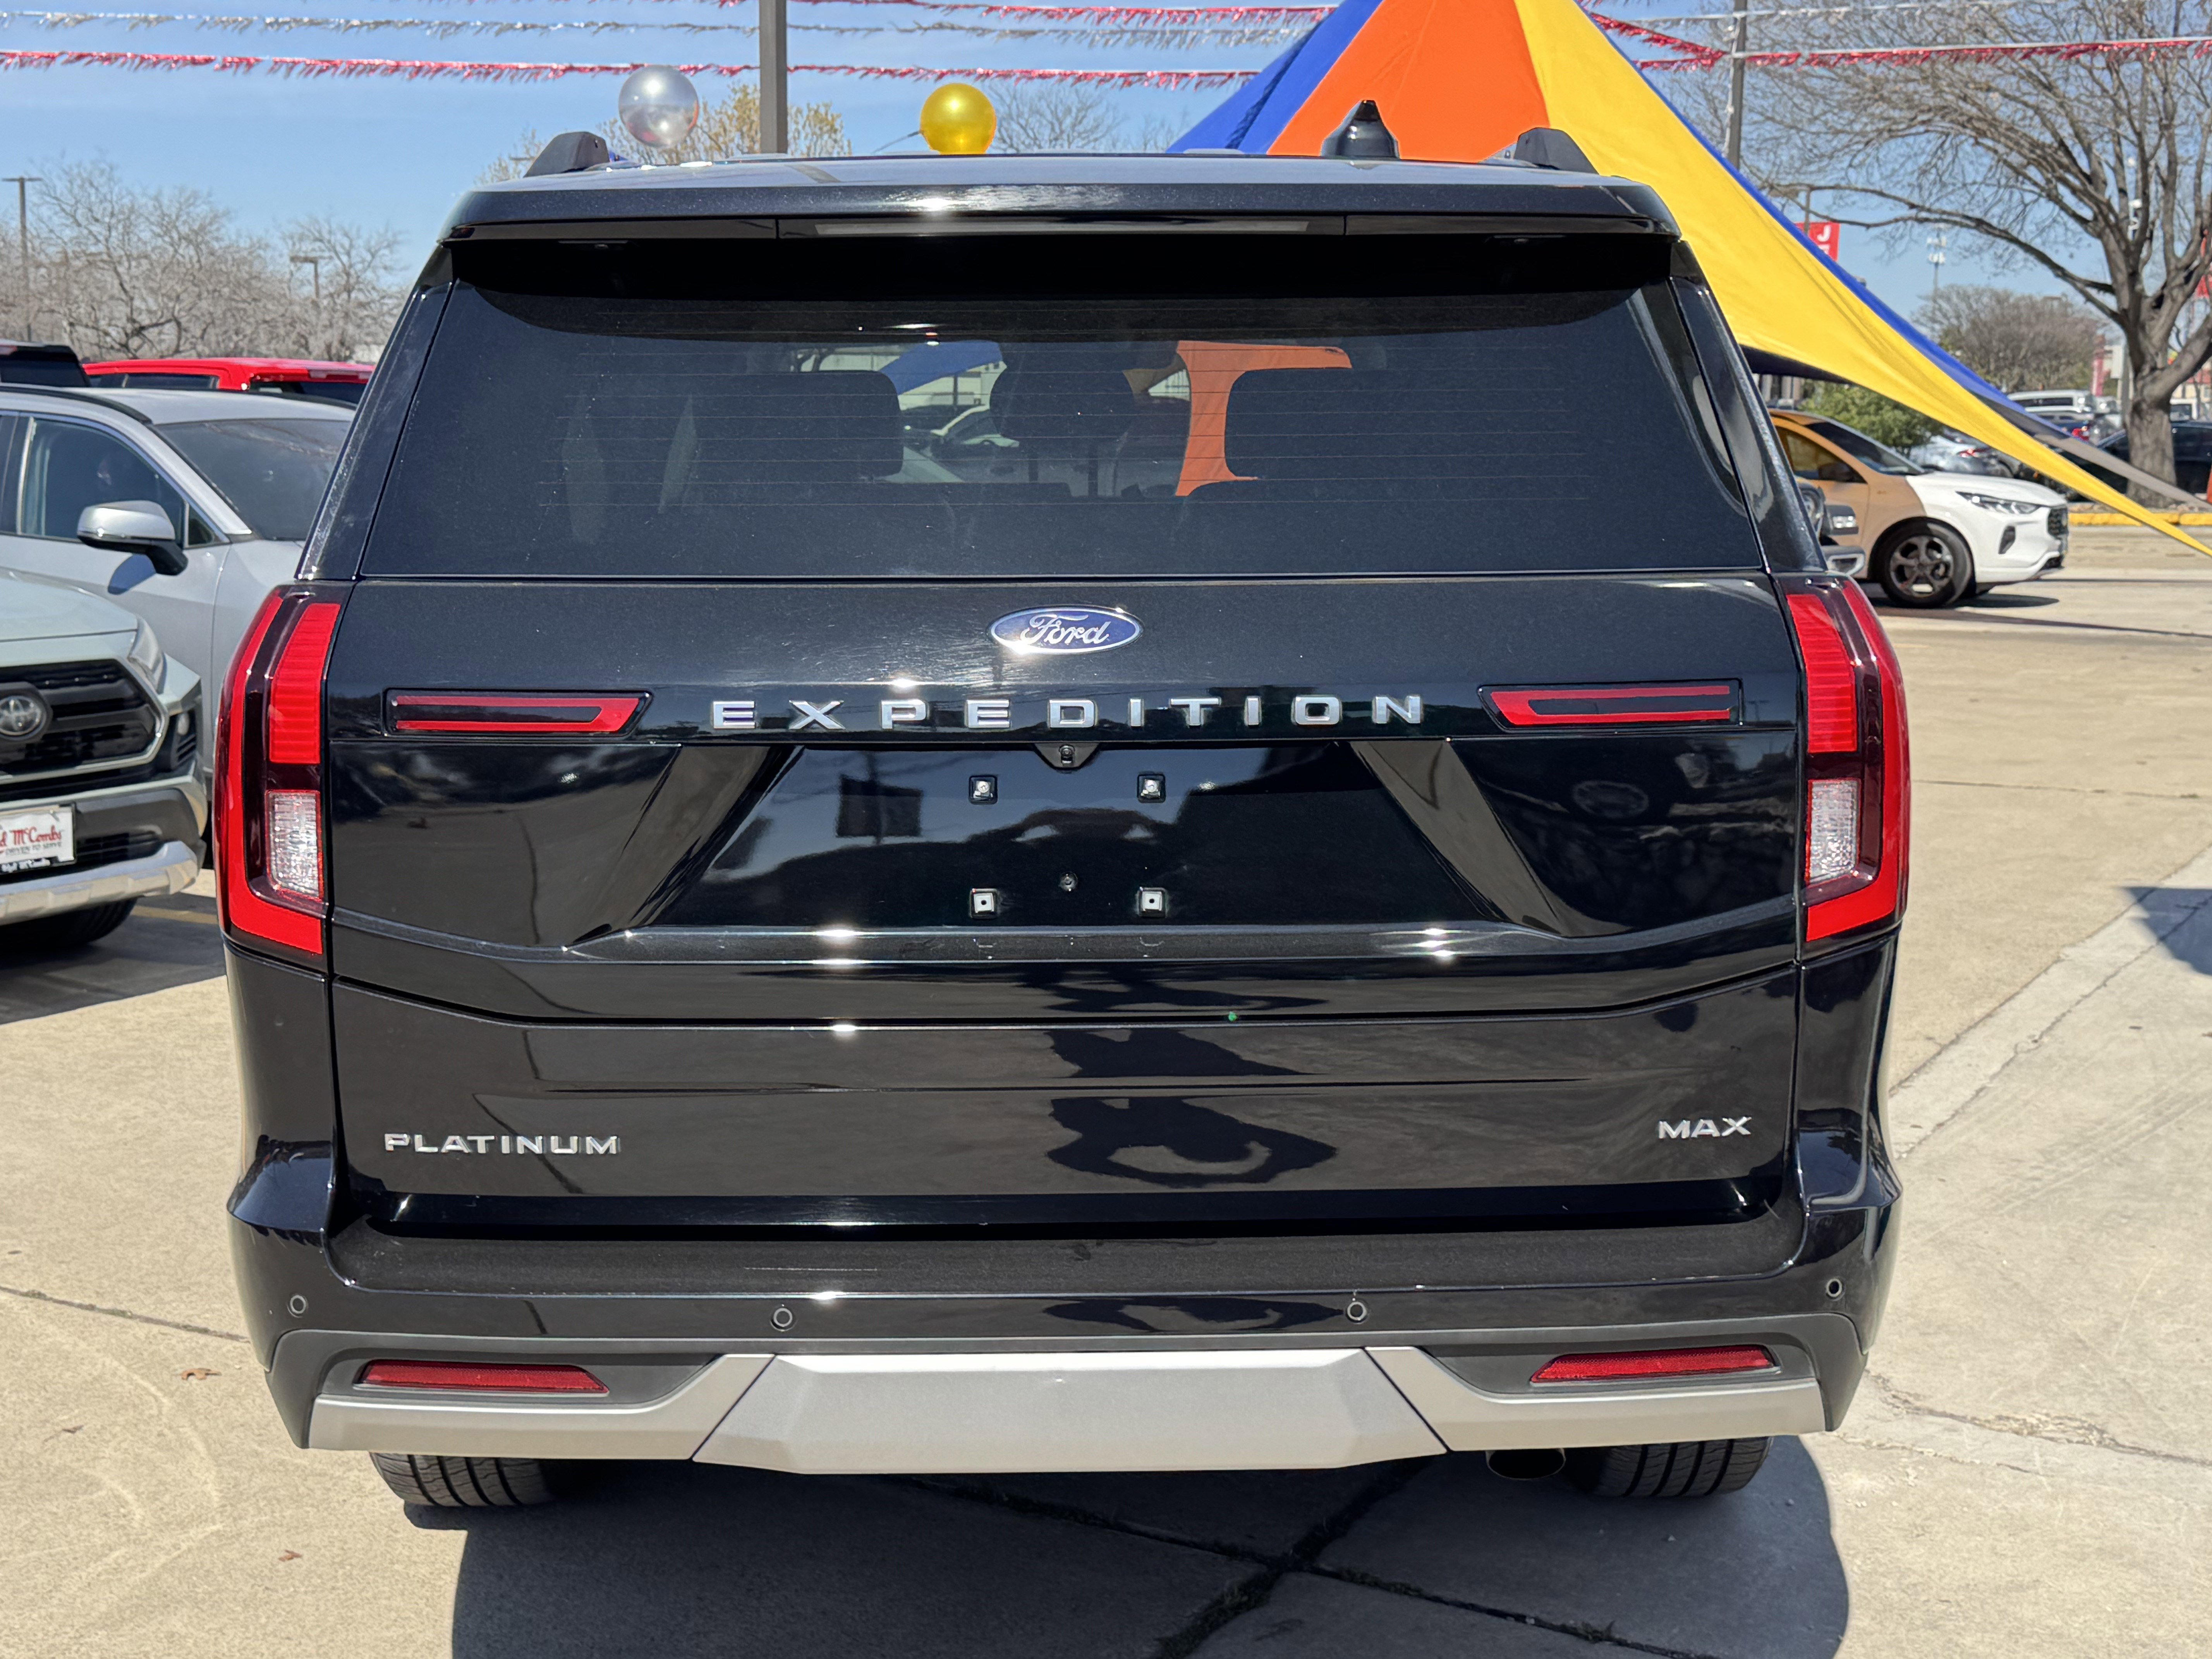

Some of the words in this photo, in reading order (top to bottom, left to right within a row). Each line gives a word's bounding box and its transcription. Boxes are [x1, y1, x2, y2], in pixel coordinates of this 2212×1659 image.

[1020, 614, 1111, 645] Ford
[711, 695, 1424, 730] EXPEDITION
[1659, 1116, 1752, 1139] MAX
[384, 1133, 620, 1154] PLATINUM
